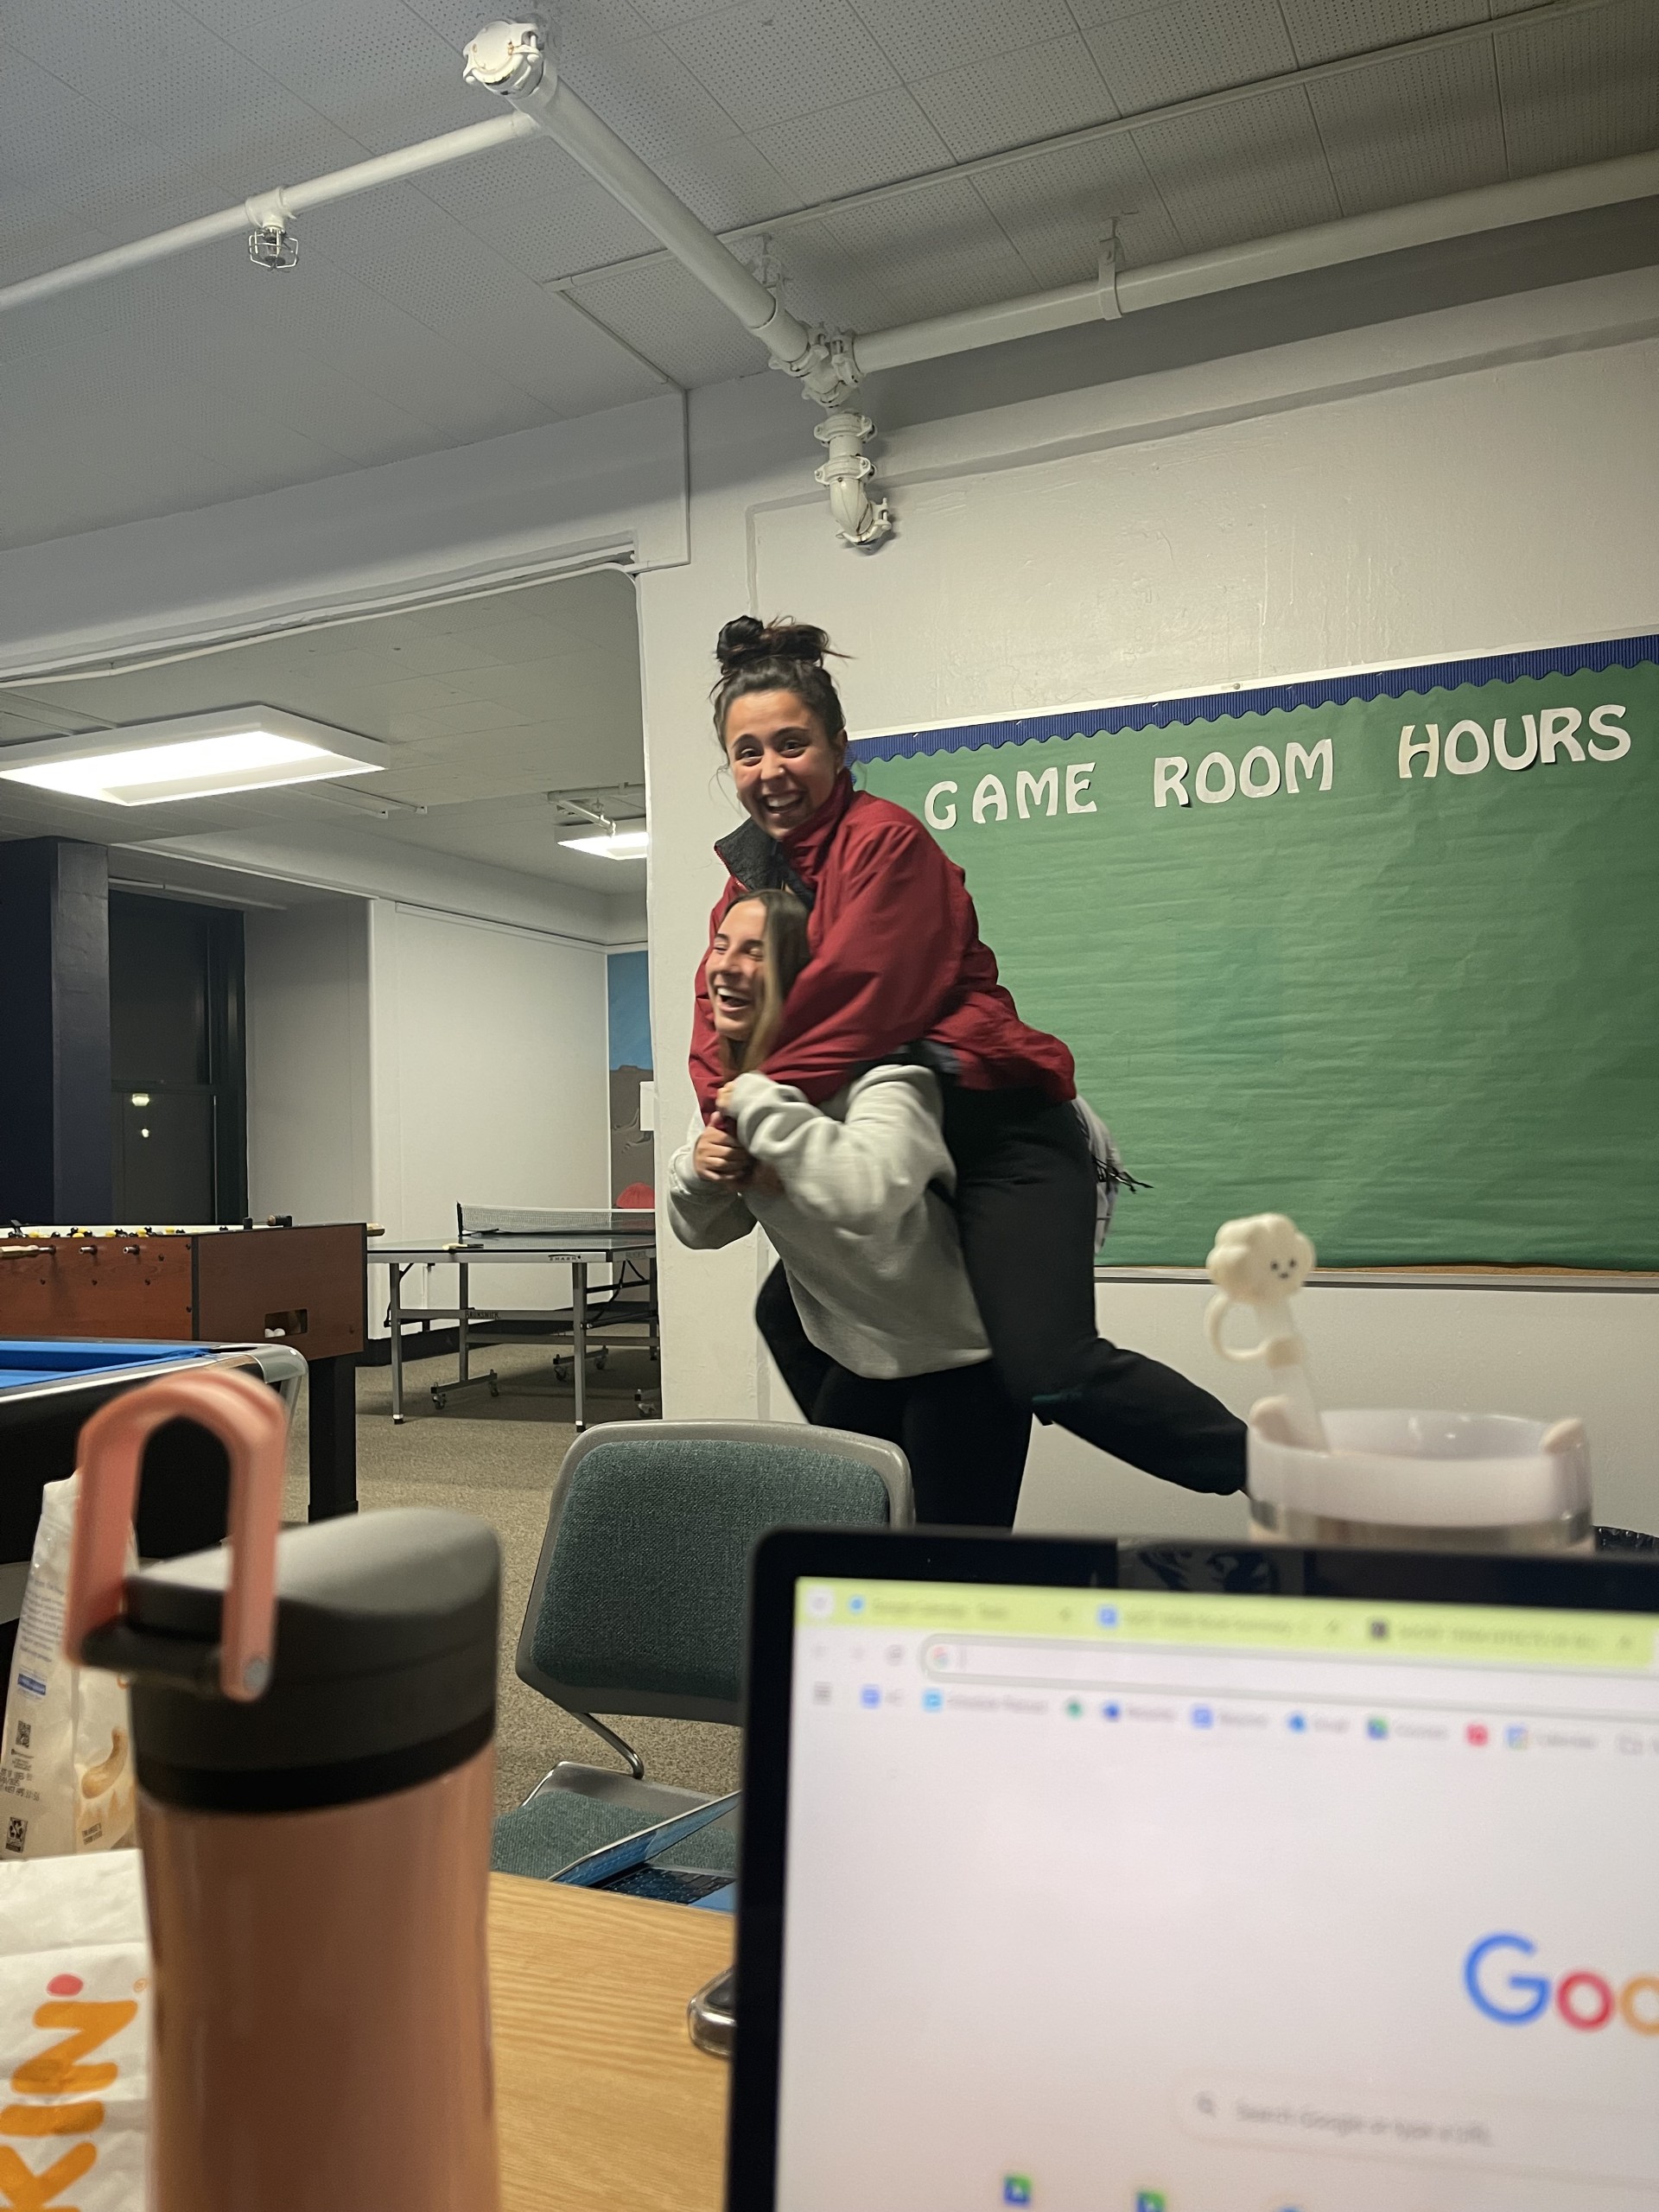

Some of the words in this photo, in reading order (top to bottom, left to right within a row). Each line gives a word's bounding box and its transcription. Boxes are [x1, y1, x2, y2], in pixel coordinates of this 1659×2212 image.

[924, 762, 1097, 830] GAME
[1154, 738, 1333, 808] ROOM
[1398, 704, 1631, 779] HOURS
